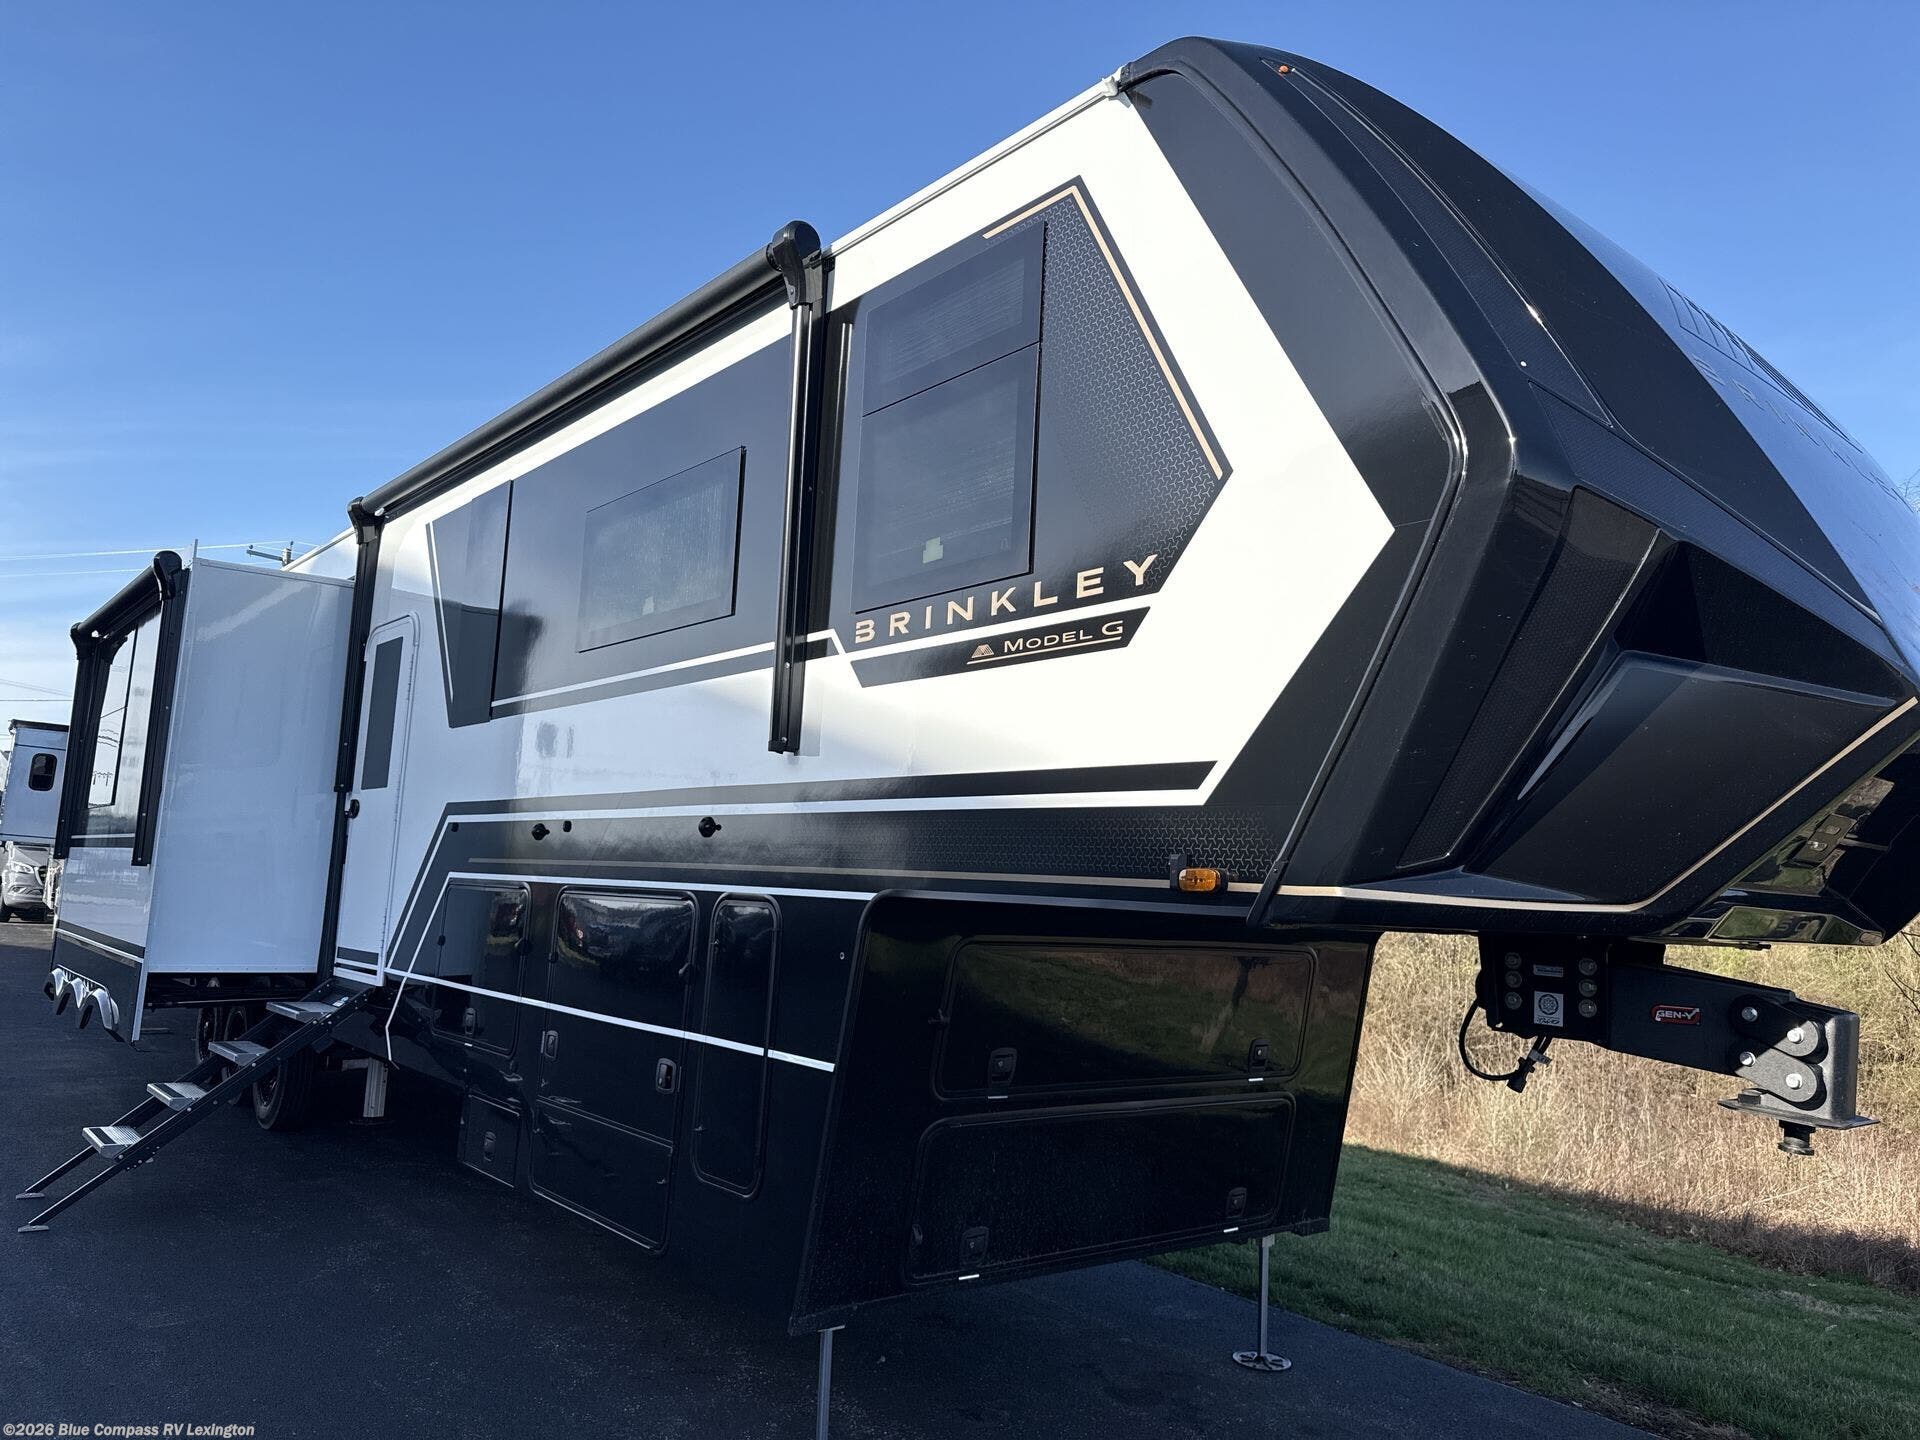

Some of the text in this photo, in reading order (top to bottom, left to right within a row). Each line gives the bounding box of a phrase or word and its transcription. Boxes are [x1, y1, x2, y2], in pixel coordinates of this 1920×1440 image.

[854, 554, 1158, 644] BRINKLEY
[1101, 620, 1124, 636] G
[1655, 1007, 1700, 1021] GEN-Y
